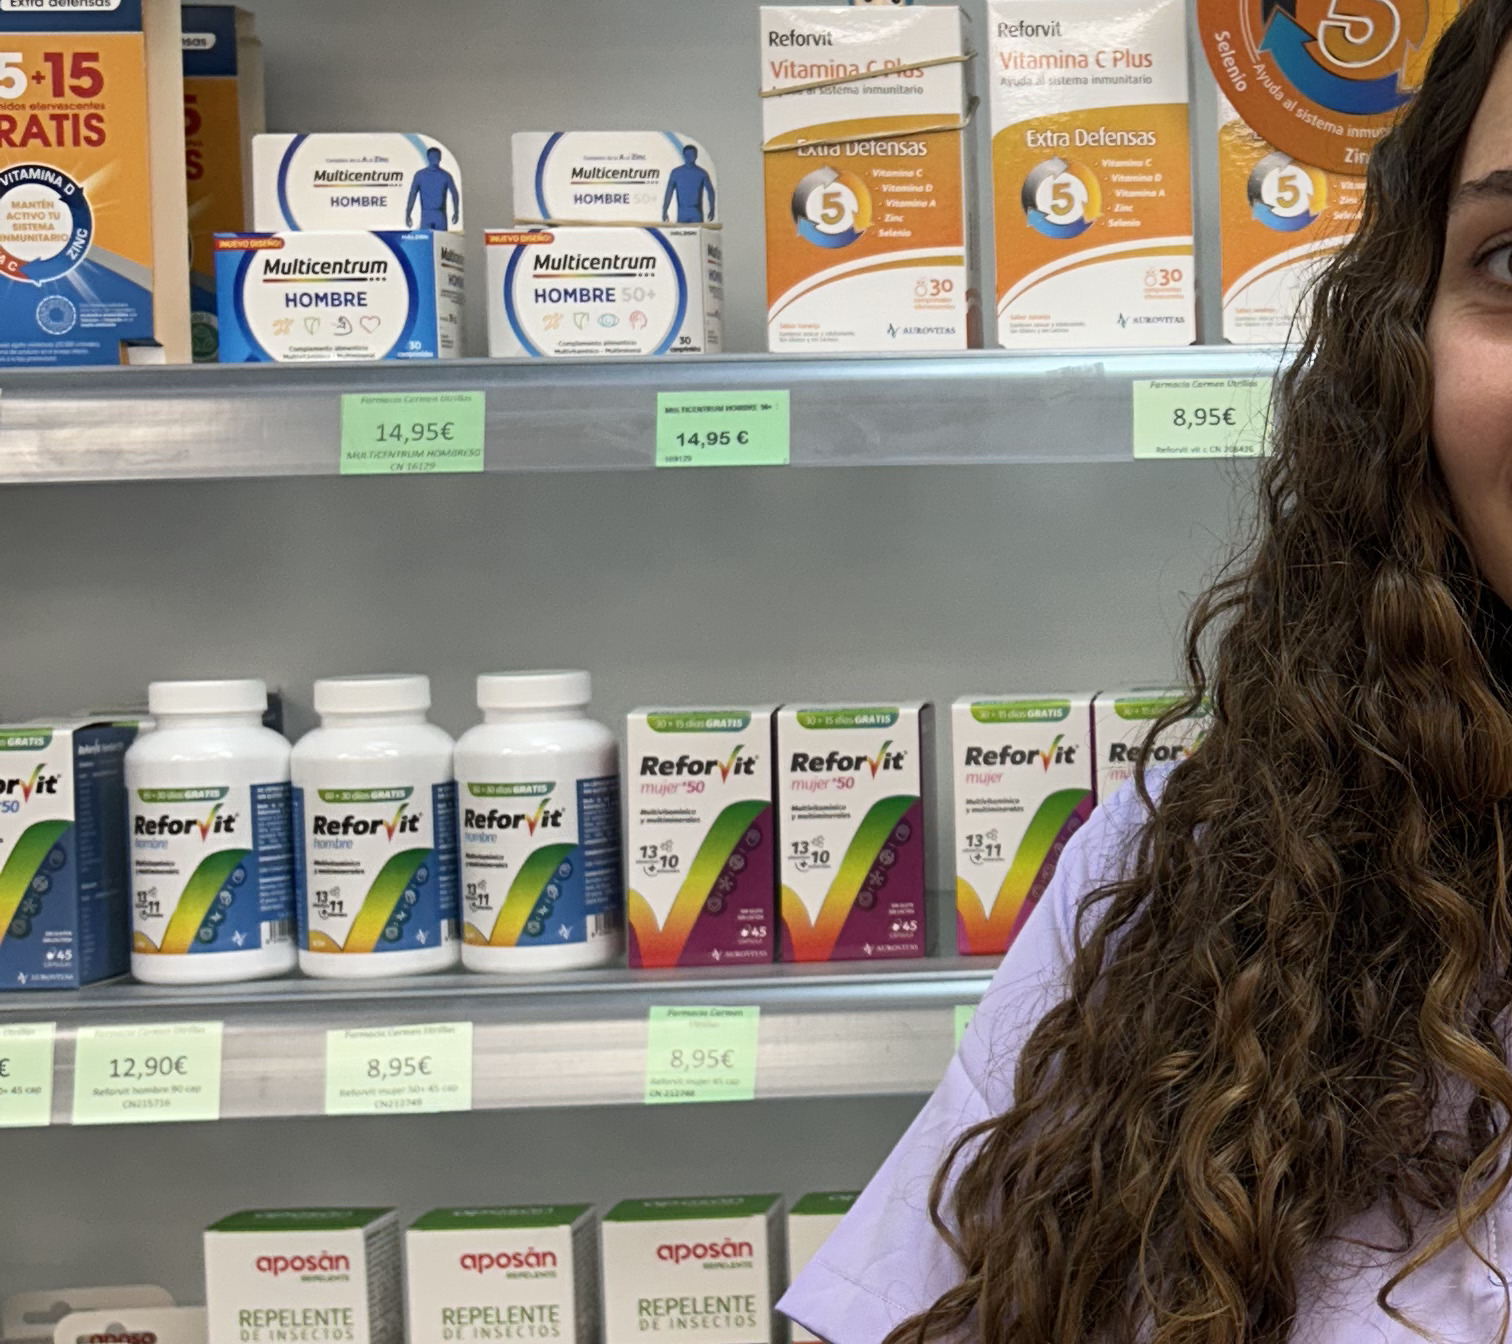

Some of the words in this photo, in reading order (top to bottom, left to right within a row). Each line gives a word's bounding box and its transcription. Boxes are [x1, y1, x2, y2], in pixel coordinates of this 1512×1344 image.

[997, 21, 1062, 40] Reforvit
[999, 50, 1090, 71] Vitamina
[1095, 49, 1107, 69] C
[1111, 49, 1153, 69] Plus
[1215, 30, 1247, 93] Selenio
[1026, 128, 1071, 149] Extra
[1074, 128, 1157, 148] Defensas
[263, 257, 388, 277] Multicentrum
[533, 254, 657, 271] Multicentrum
[1158, 268, 1183, 286] 30
[284, 291, 368, 308] HOMBRE
[534, 288, 616, 304] HOMBRE
[1172, 407, 1237, 429] 8,95€
[375, 422, 455, 443] 14,95€
[108, 1055, 189, 1079] 12,90€
[367, 1055, 432, 1078] 8,95€
[239, 1308, 354, 1328] REPELENTE
[240, 1328, 262, 1342] DE
[269, 1326, 354, 1342] INSECTOS
